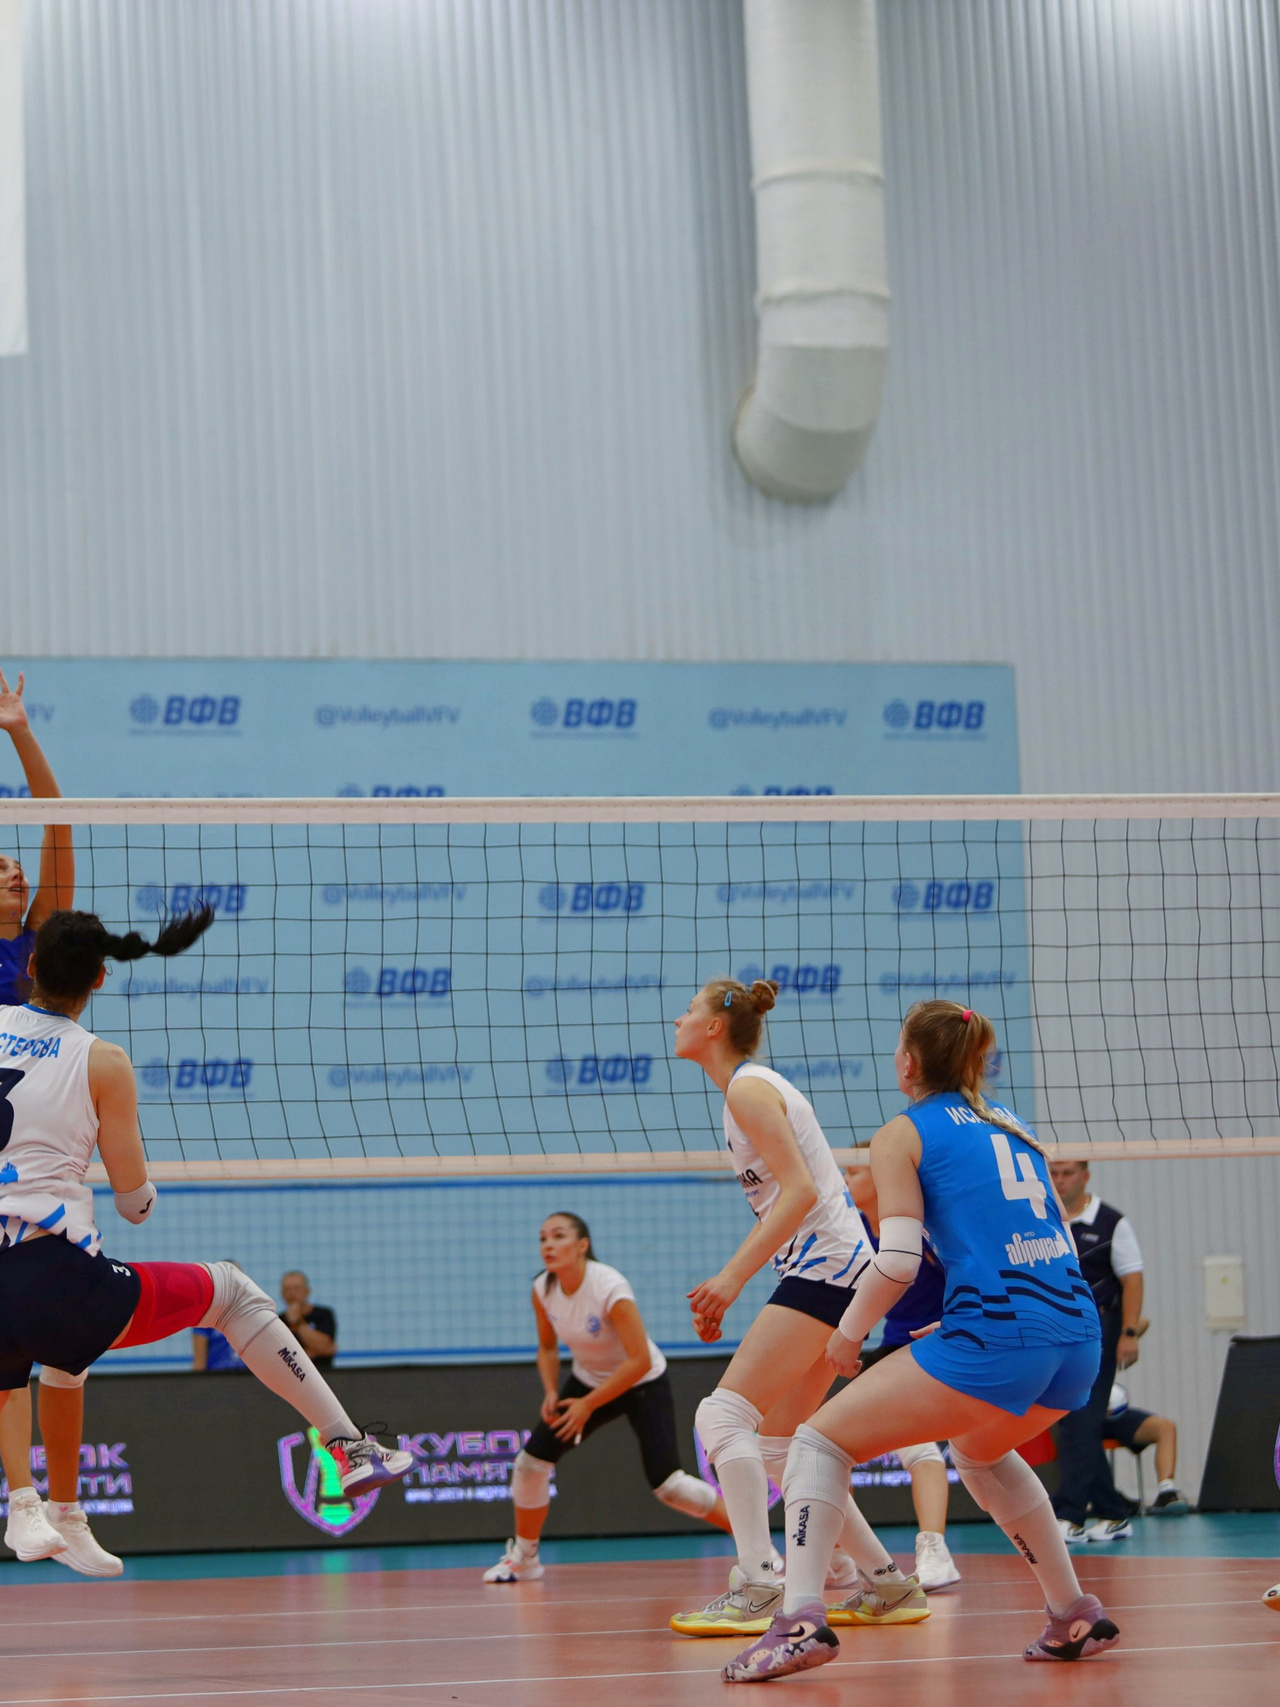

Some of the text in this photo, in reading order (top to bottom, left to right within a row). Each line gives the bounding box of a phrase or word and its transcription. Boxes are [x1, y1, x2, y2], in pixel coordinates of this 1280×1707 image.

[163, 694, 241, 726] ВФВ
[314, 705, 460, 729] @VolleyballVFV
[563, 697, 638, 729] ВФВ
[709, 707, 847, 732] @VolleyballVFV
[914, 701, 985, 731] ВФВ
[323, 883, 467, 907] @VolleyballVFV
[571, 882, 645, 913] ВФВ
[922, 880, 994, 911] ВФВ
[121, 976, 268, 1001] @VolleyballVFV
[375, 967, 451, 998] ВФВ
[176, 1058, 254, 1089] ВФВ
[327, 1064, 473, 1089] @VolleyballVFV
[577, 1053, 652, 1085] ВФВ
[991, 1133, 1047, 1219] 4
[277, 1347, 306, 1382] MIKASA
[795, 1505, 810, 1547] MIKASA
[1013, 1533, 1038, 1564] MIKASA
